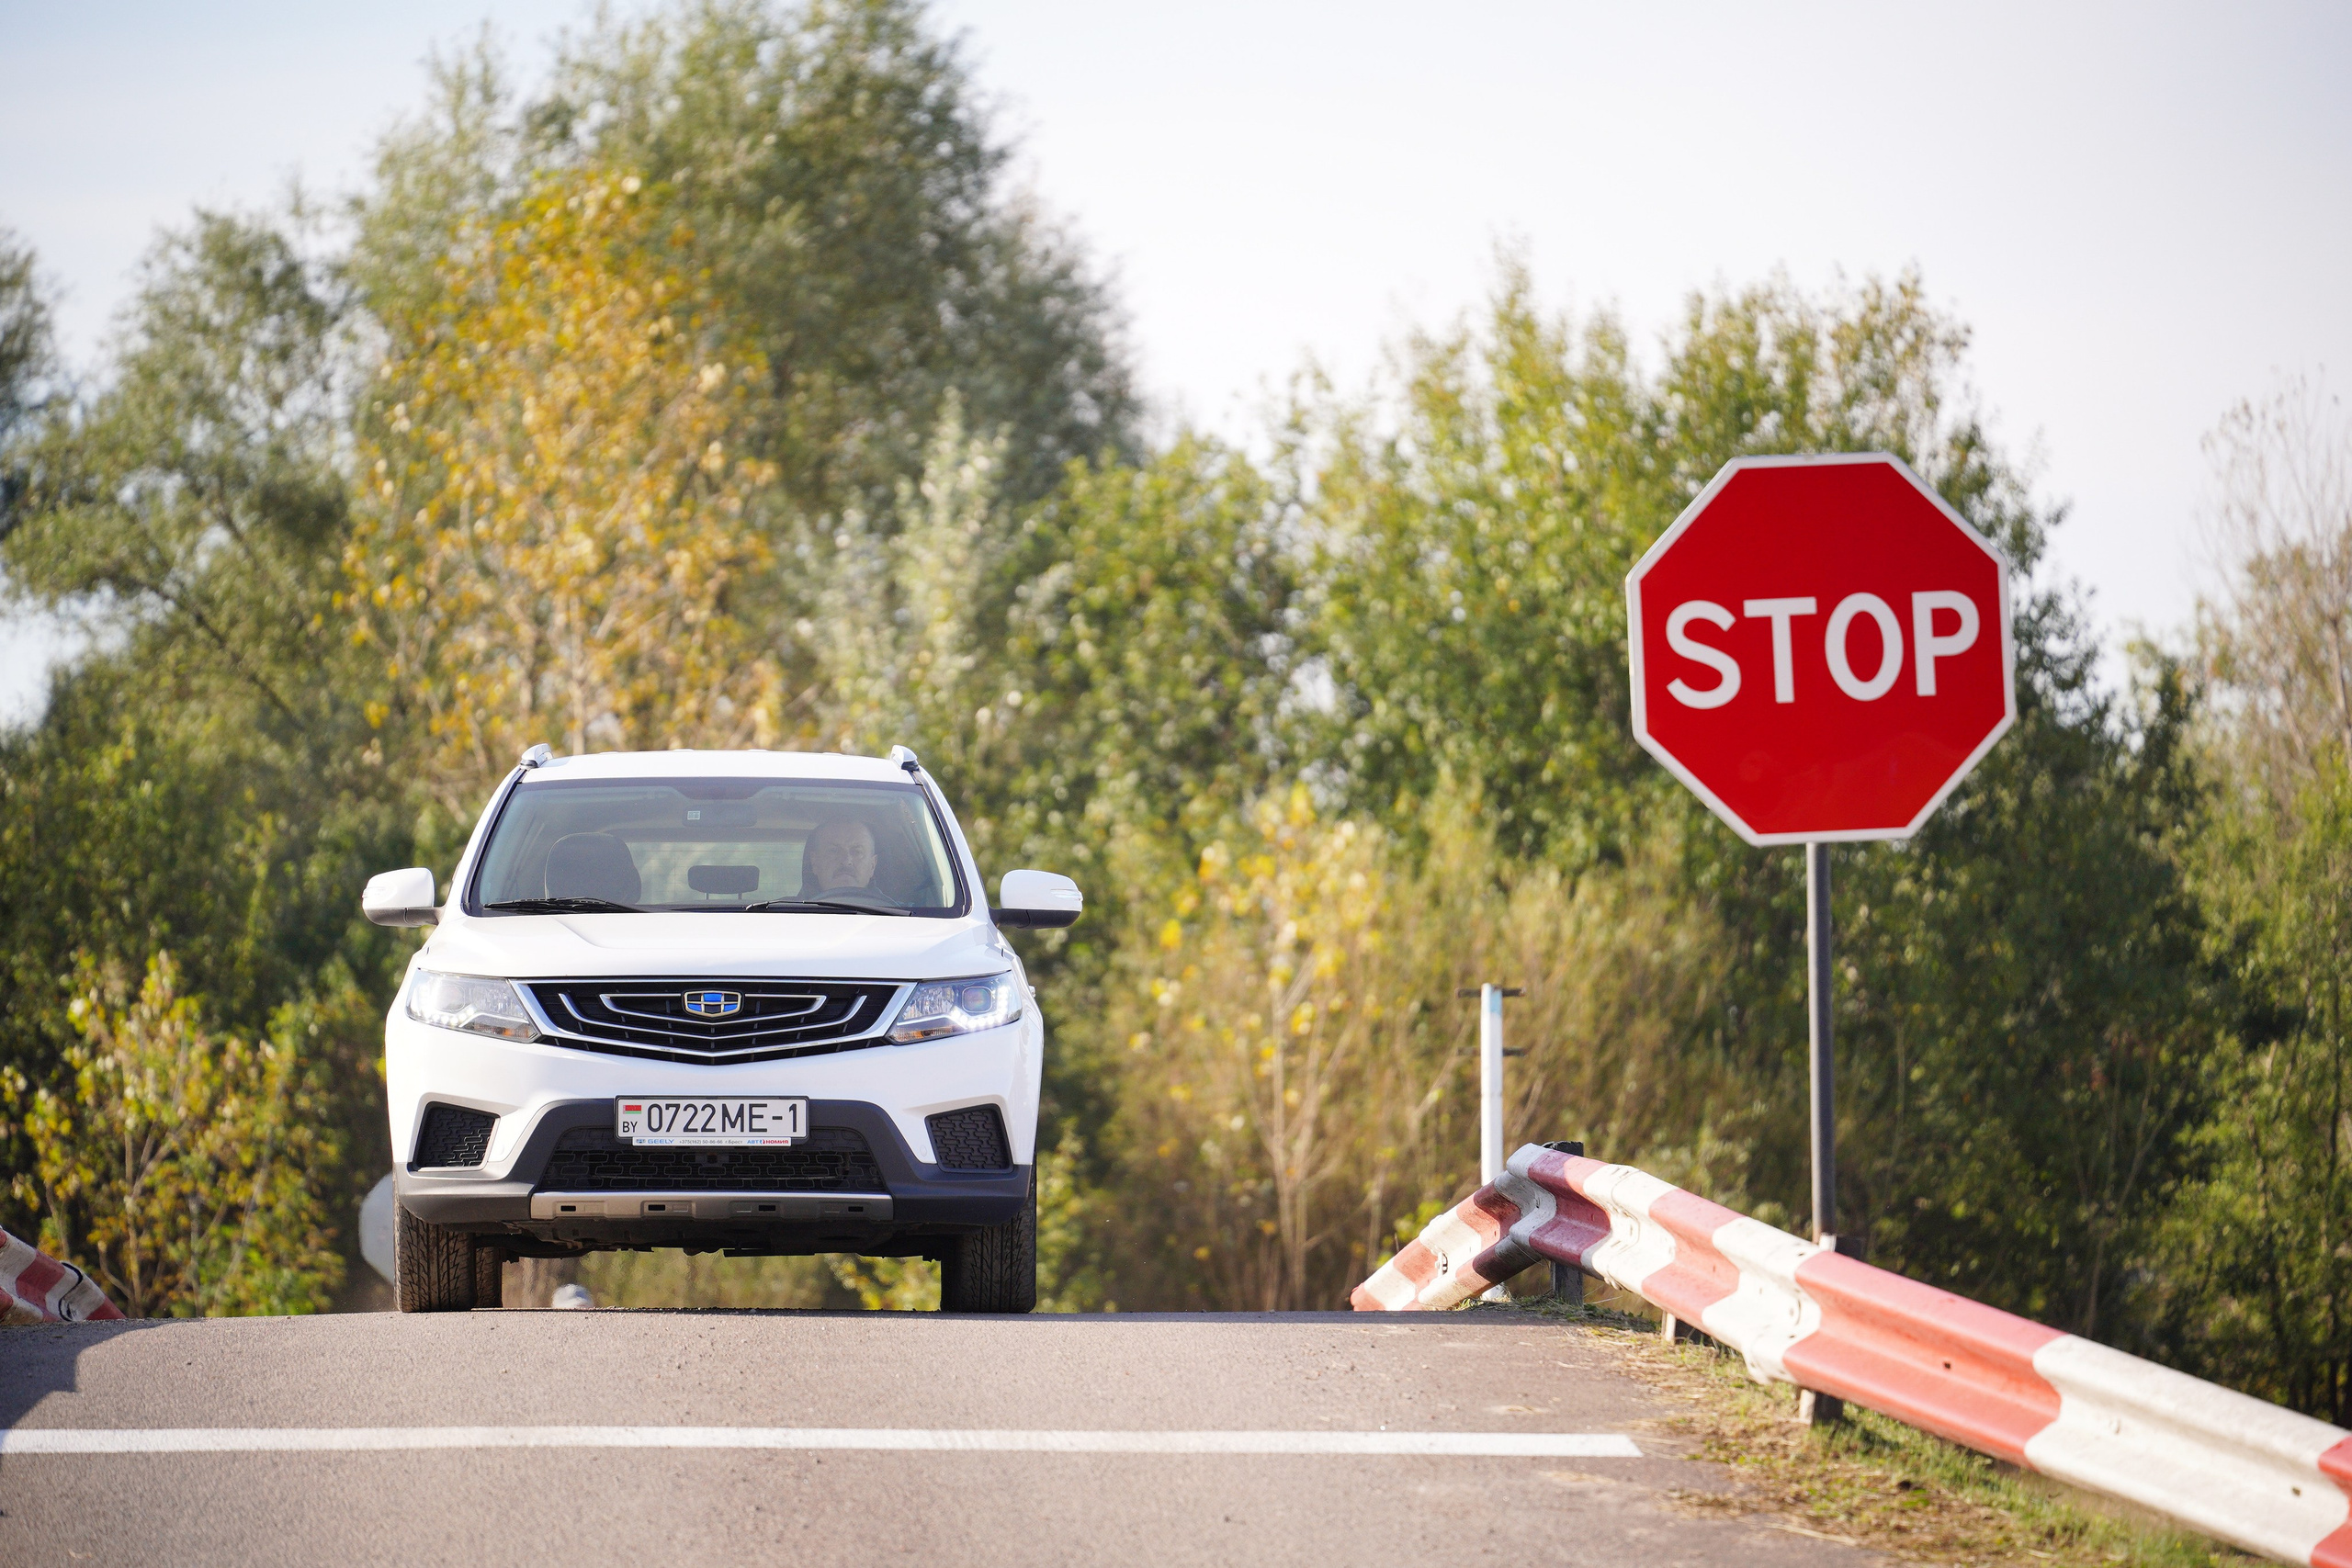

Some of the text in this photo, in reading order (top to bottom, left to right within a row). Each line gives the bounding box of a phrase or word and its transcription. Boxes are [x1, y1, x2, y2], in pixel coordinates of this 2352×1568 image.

[1666, 590, 1980, 709] STOP
[622, 1121, 638, 1133] BY
[647, 1103, 797, 1133] 0722ME-1
